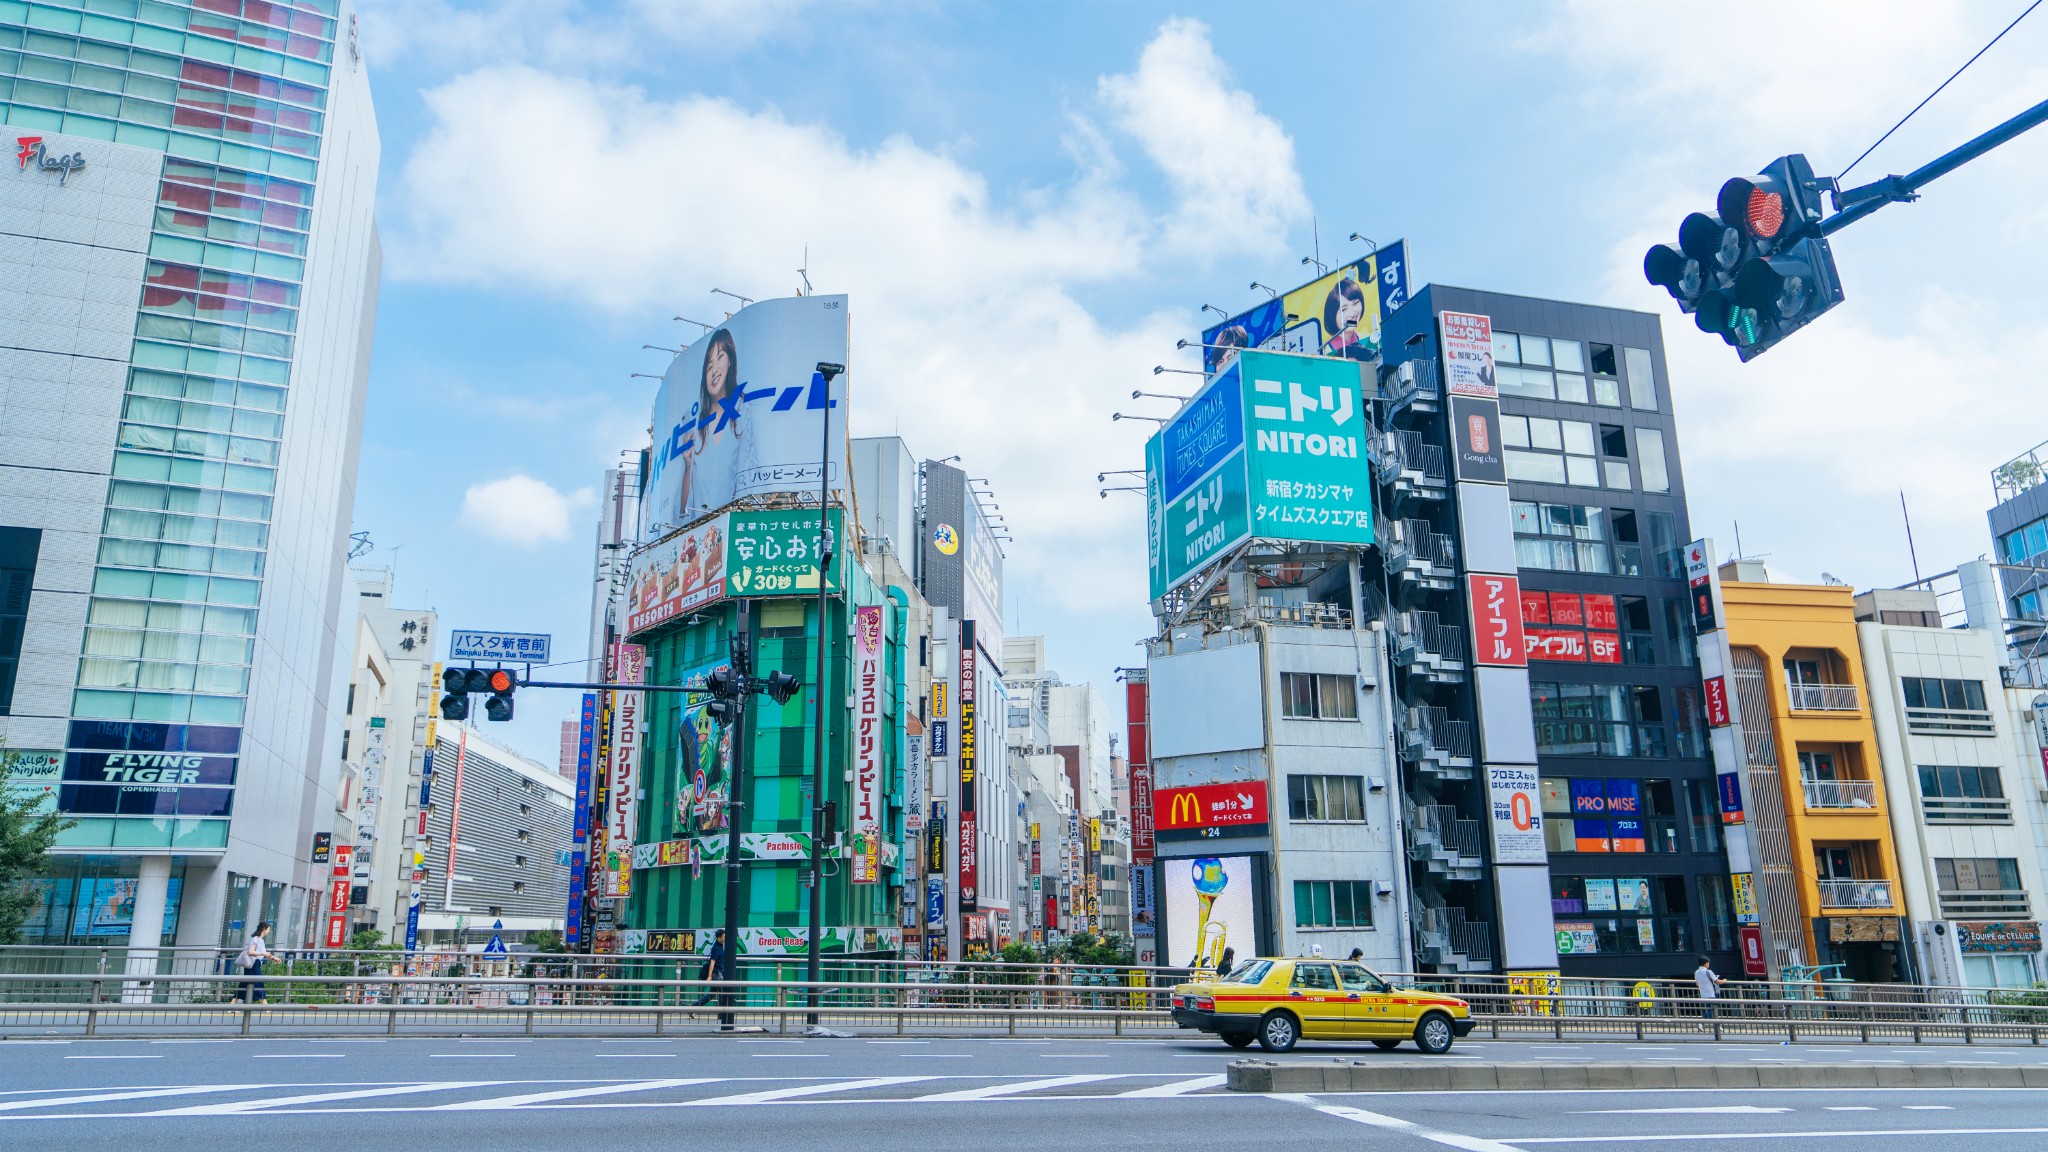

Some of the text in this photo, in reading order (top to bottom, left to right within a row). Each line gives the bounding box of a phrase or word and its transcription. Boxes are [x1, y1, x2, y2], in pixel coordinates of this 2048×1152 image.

[16, 136, 86, 185] Flags
[1254, 379, 1354, 426] ニトリ
[1176, 390, 1225, 448] TAKASHIMAYA
[1178, 416, 1226, 477] TIMES SQUARE
[1257, 429, 1358, 459] NITORI
[1464, 453, 1498, 464] Gong cha
[1266, 479, 1354, 502] 新宿タカシマヤ
[1185, 473, 1223, 536] ニトリ
[1255, 503, 1368, 529] タイムズスクエア店
[1186, 520, 1226, 566] NITORI
[755, 564, 808, 574] ガードくぐって
[754, 575, 792, 590] 30秒
[633, 601, 674, 629] RESORTS
[1485, 580, 1512, 660] アイフル
[456, 634, 546, 652] バスタ新宿前
[1524, 636, 1615, 656] アイフル 6F
[455, 649, 482, 657] Shinjuku
[518, 651, 545, 660] Terminal
[1710, 680, 1725, 723] アイフル
[105, 753, 203, 769] FLYING
[8, 765, 58, 777] Shinjuku!
[103, 768, 200, 783] TIGER
[1491, 769, 1535, 781] プロミスなら
[122, 785, 178, 793] COPENHAGEN
[1491, 781, 1537, 790] はじめての方は
[1211, 799, 1238, 811] 徒歩1分
[1511, 791, 1532, 832] 0
[1494, 810, 1512, 820] 利息
[1530, 817, 1540, 830] 円
[1617, 821, 1638, 829] プロミス
[1208, 827, 1221, 837] 24
[766, 842, 802, 851] Pachislo
[335, 883, 345, 909] マルハン
[931, 891, 940, 918] アース
[1743, 914, 1753, 922] 2F
[758, 938, 804, 946] Green Peas
[1558, 932, 1571, 950] 占
[2006, 932, 2034, 940] CELLIER
